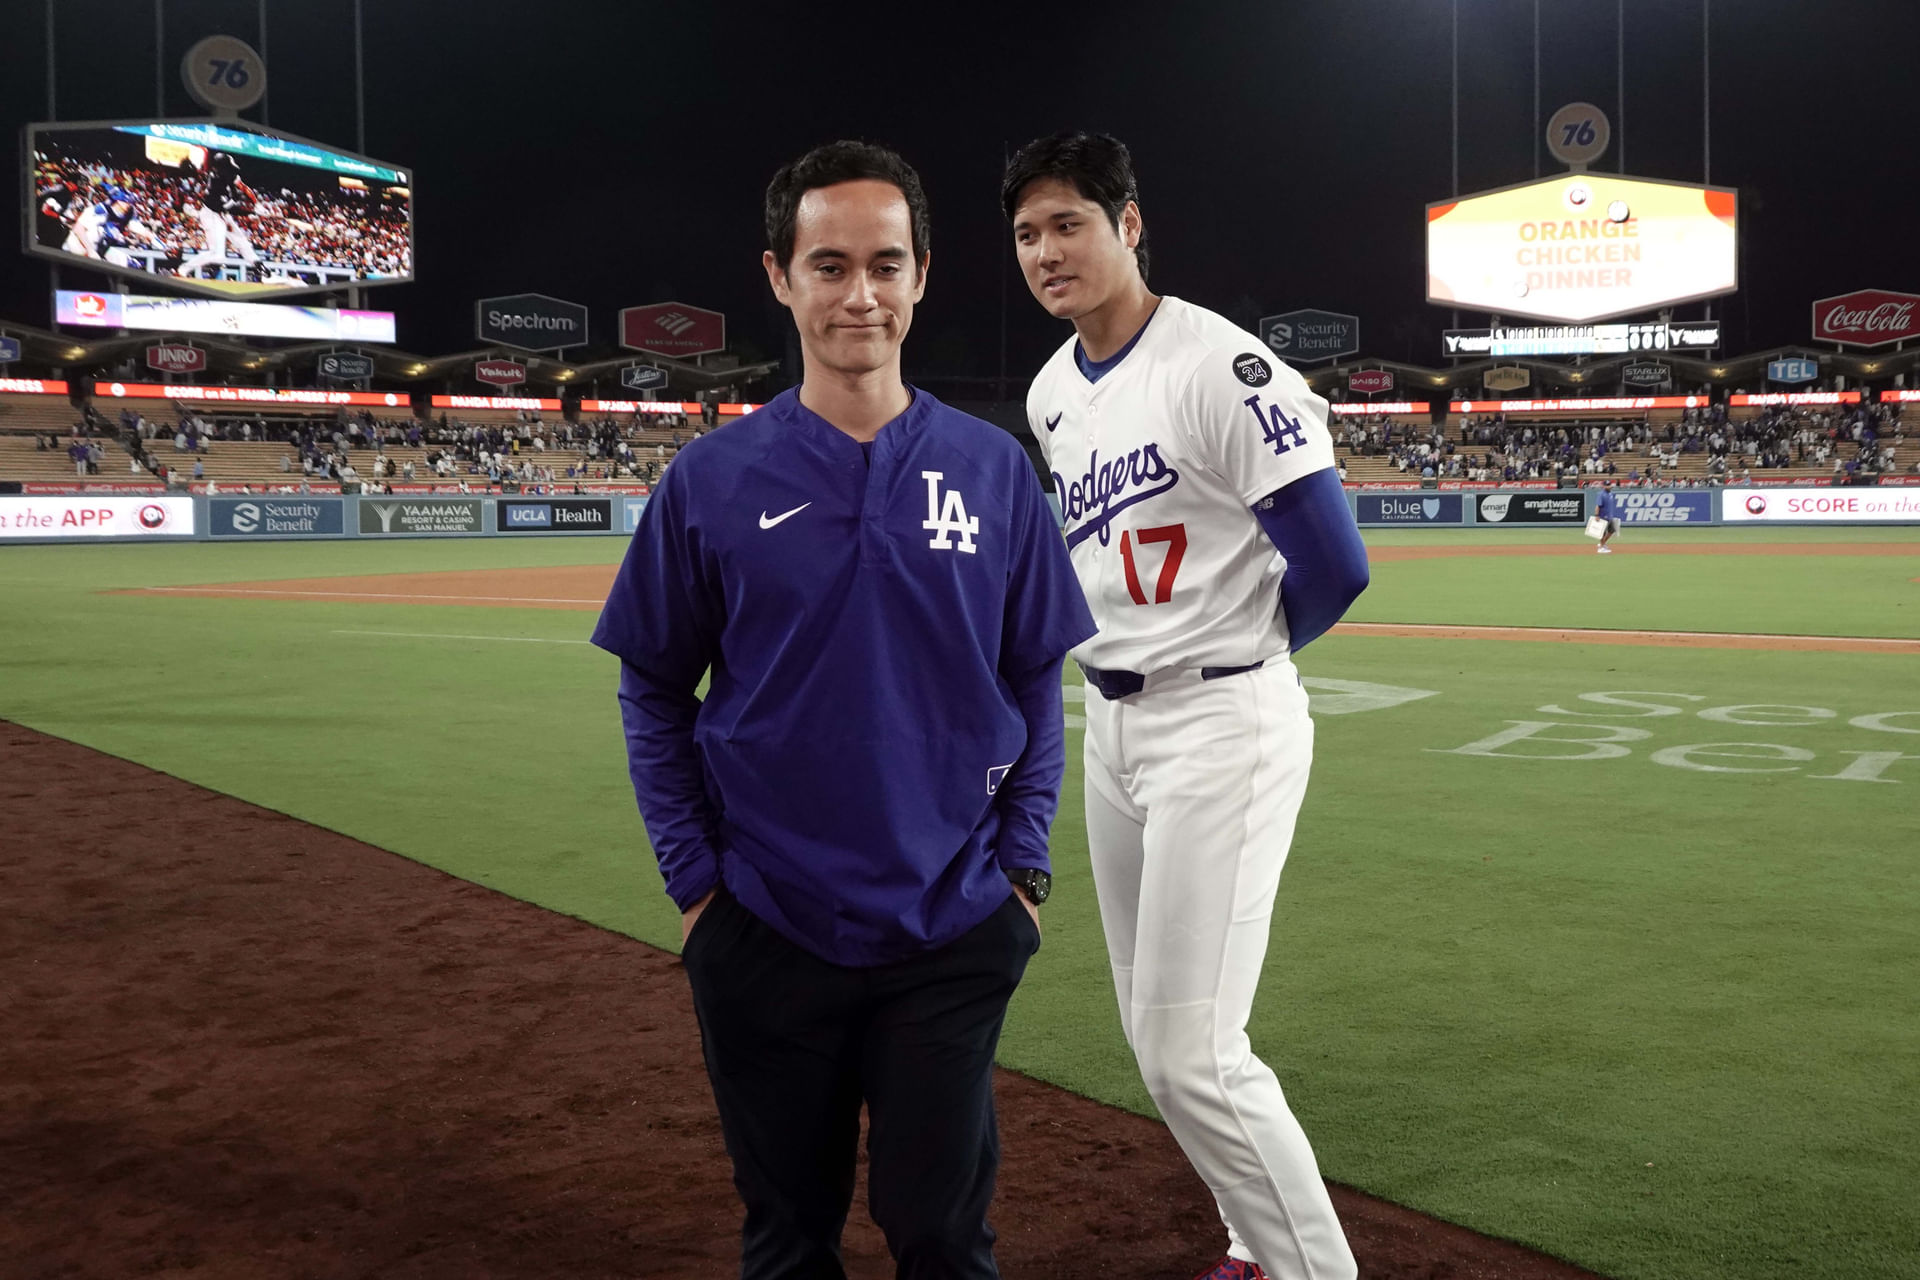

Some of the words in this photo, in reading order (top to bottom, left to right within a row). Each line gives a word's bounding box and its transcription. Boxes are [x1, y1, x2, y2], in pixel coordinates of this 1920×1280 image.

[208, 60, 249, 88] 76
[1562, 120, 1596, 146] 76
[1519, 217, 1639, 242] ORANGE
[1516, 243, 1642, 266] CHICKEN
[1526, 268, 1633, 290] DINNER
[488, 310, 573, 332] Spectrum
[1297, 322, 1350, 336] Security
[1298, 336, 1341, 349] Benefit
[157, 348, 198, 365] JINRO
[480, 367, 523, 378] Yakult
[1242, 362, 1267, 383] 34
[1625, 367, 1668, 376] STARLUX
[1774, 362, 1812, 378] TEL
[450, 396, 490, 407] PANDA
[491, 397, 542, 409] EXPRESS
[1748, 394, 1787, 405] PANDA
[1788, 393, 1840, 404] EXPRESS
[1244, 394, 1308, 456] LA
[1381, 499, 1421, 514] blue
[1482, 503, 1507, 511] smart
[1524, 499, 1580, 508] smartwater
[1614, 493, 1675, 508] TOYO
[1788, 498, 1859, 512] SCORE
[1865, 501, 1888, 512] on
[16, 507, 53, 528] the
[61, 509, 114, 527] APP
[264, 503, 320, 520] Security
[512, 509, 546, 522] UCLA
[555, 508, 602, 523] Health
[921, 470, 979, 554] LA
[1624, 507, 1691, 521] TIRES
[266, 518, 314, 531] Benefit
[1120, 523, 1188, 606] 17
